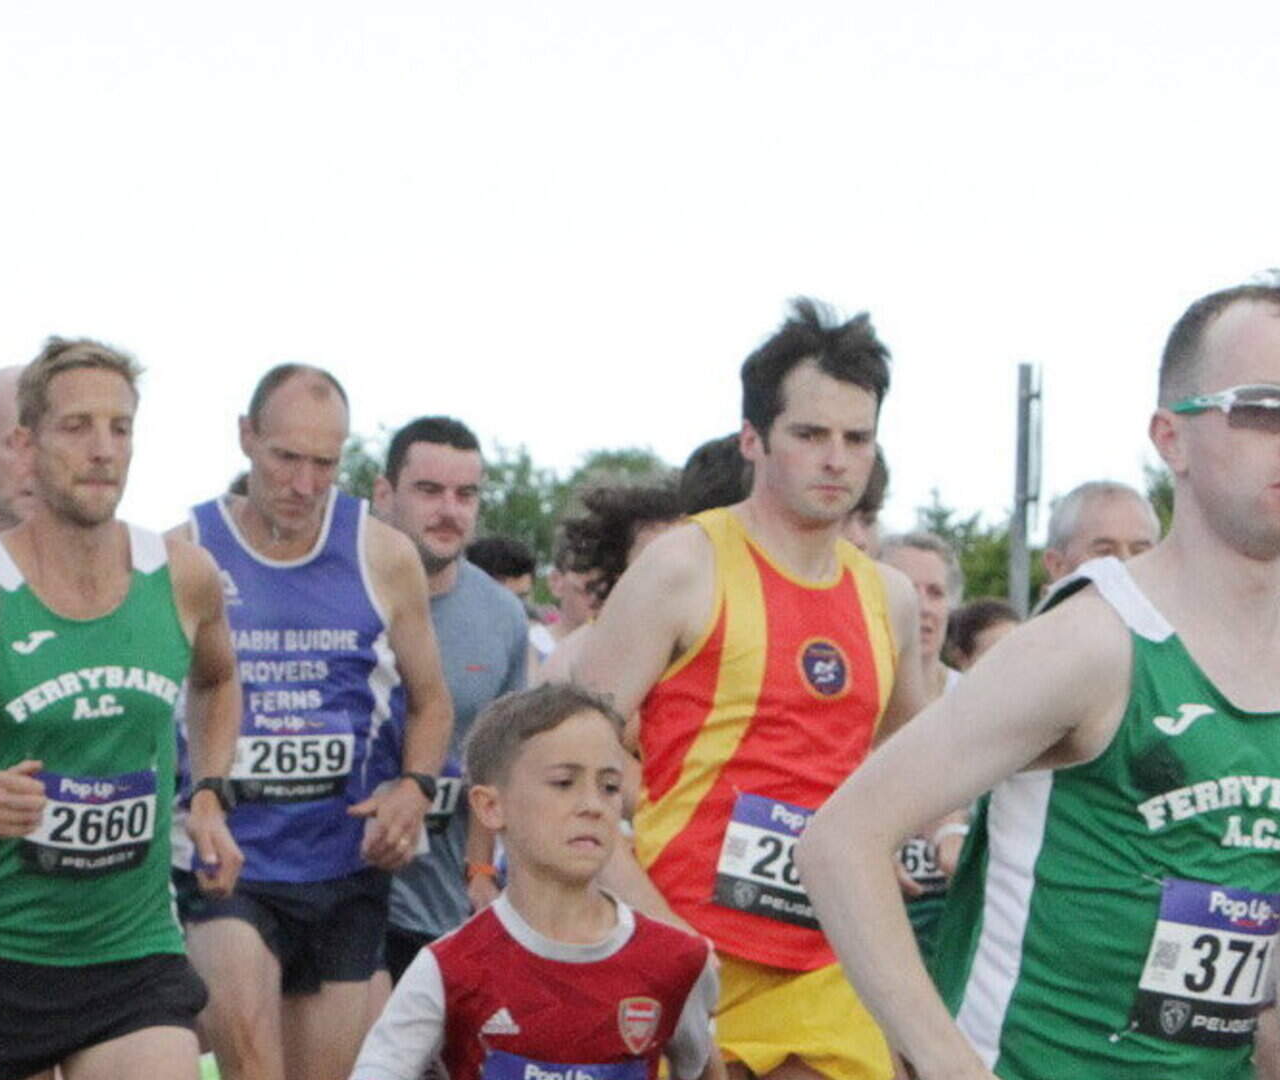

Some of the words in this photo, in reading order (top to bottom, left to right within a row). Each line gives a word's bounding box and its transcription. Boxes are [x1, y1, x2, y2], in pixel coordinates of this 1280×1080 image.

[284, 629, 359, 650] BUIDHE
[239, 660, 329, 682] ROVERS
[72, 694, 125, 721] A.C.
[249, 689, 323, 713] FERNS
[250, 739, 347, 775] 2659
[59, 778, 91, 799] Pop
[92, 781, 115, 799] Up
[48, 801, 149, 846] 2660
[1208, 890, 1249, 923] Pop
[1249, 898, 1272, 927] Up
